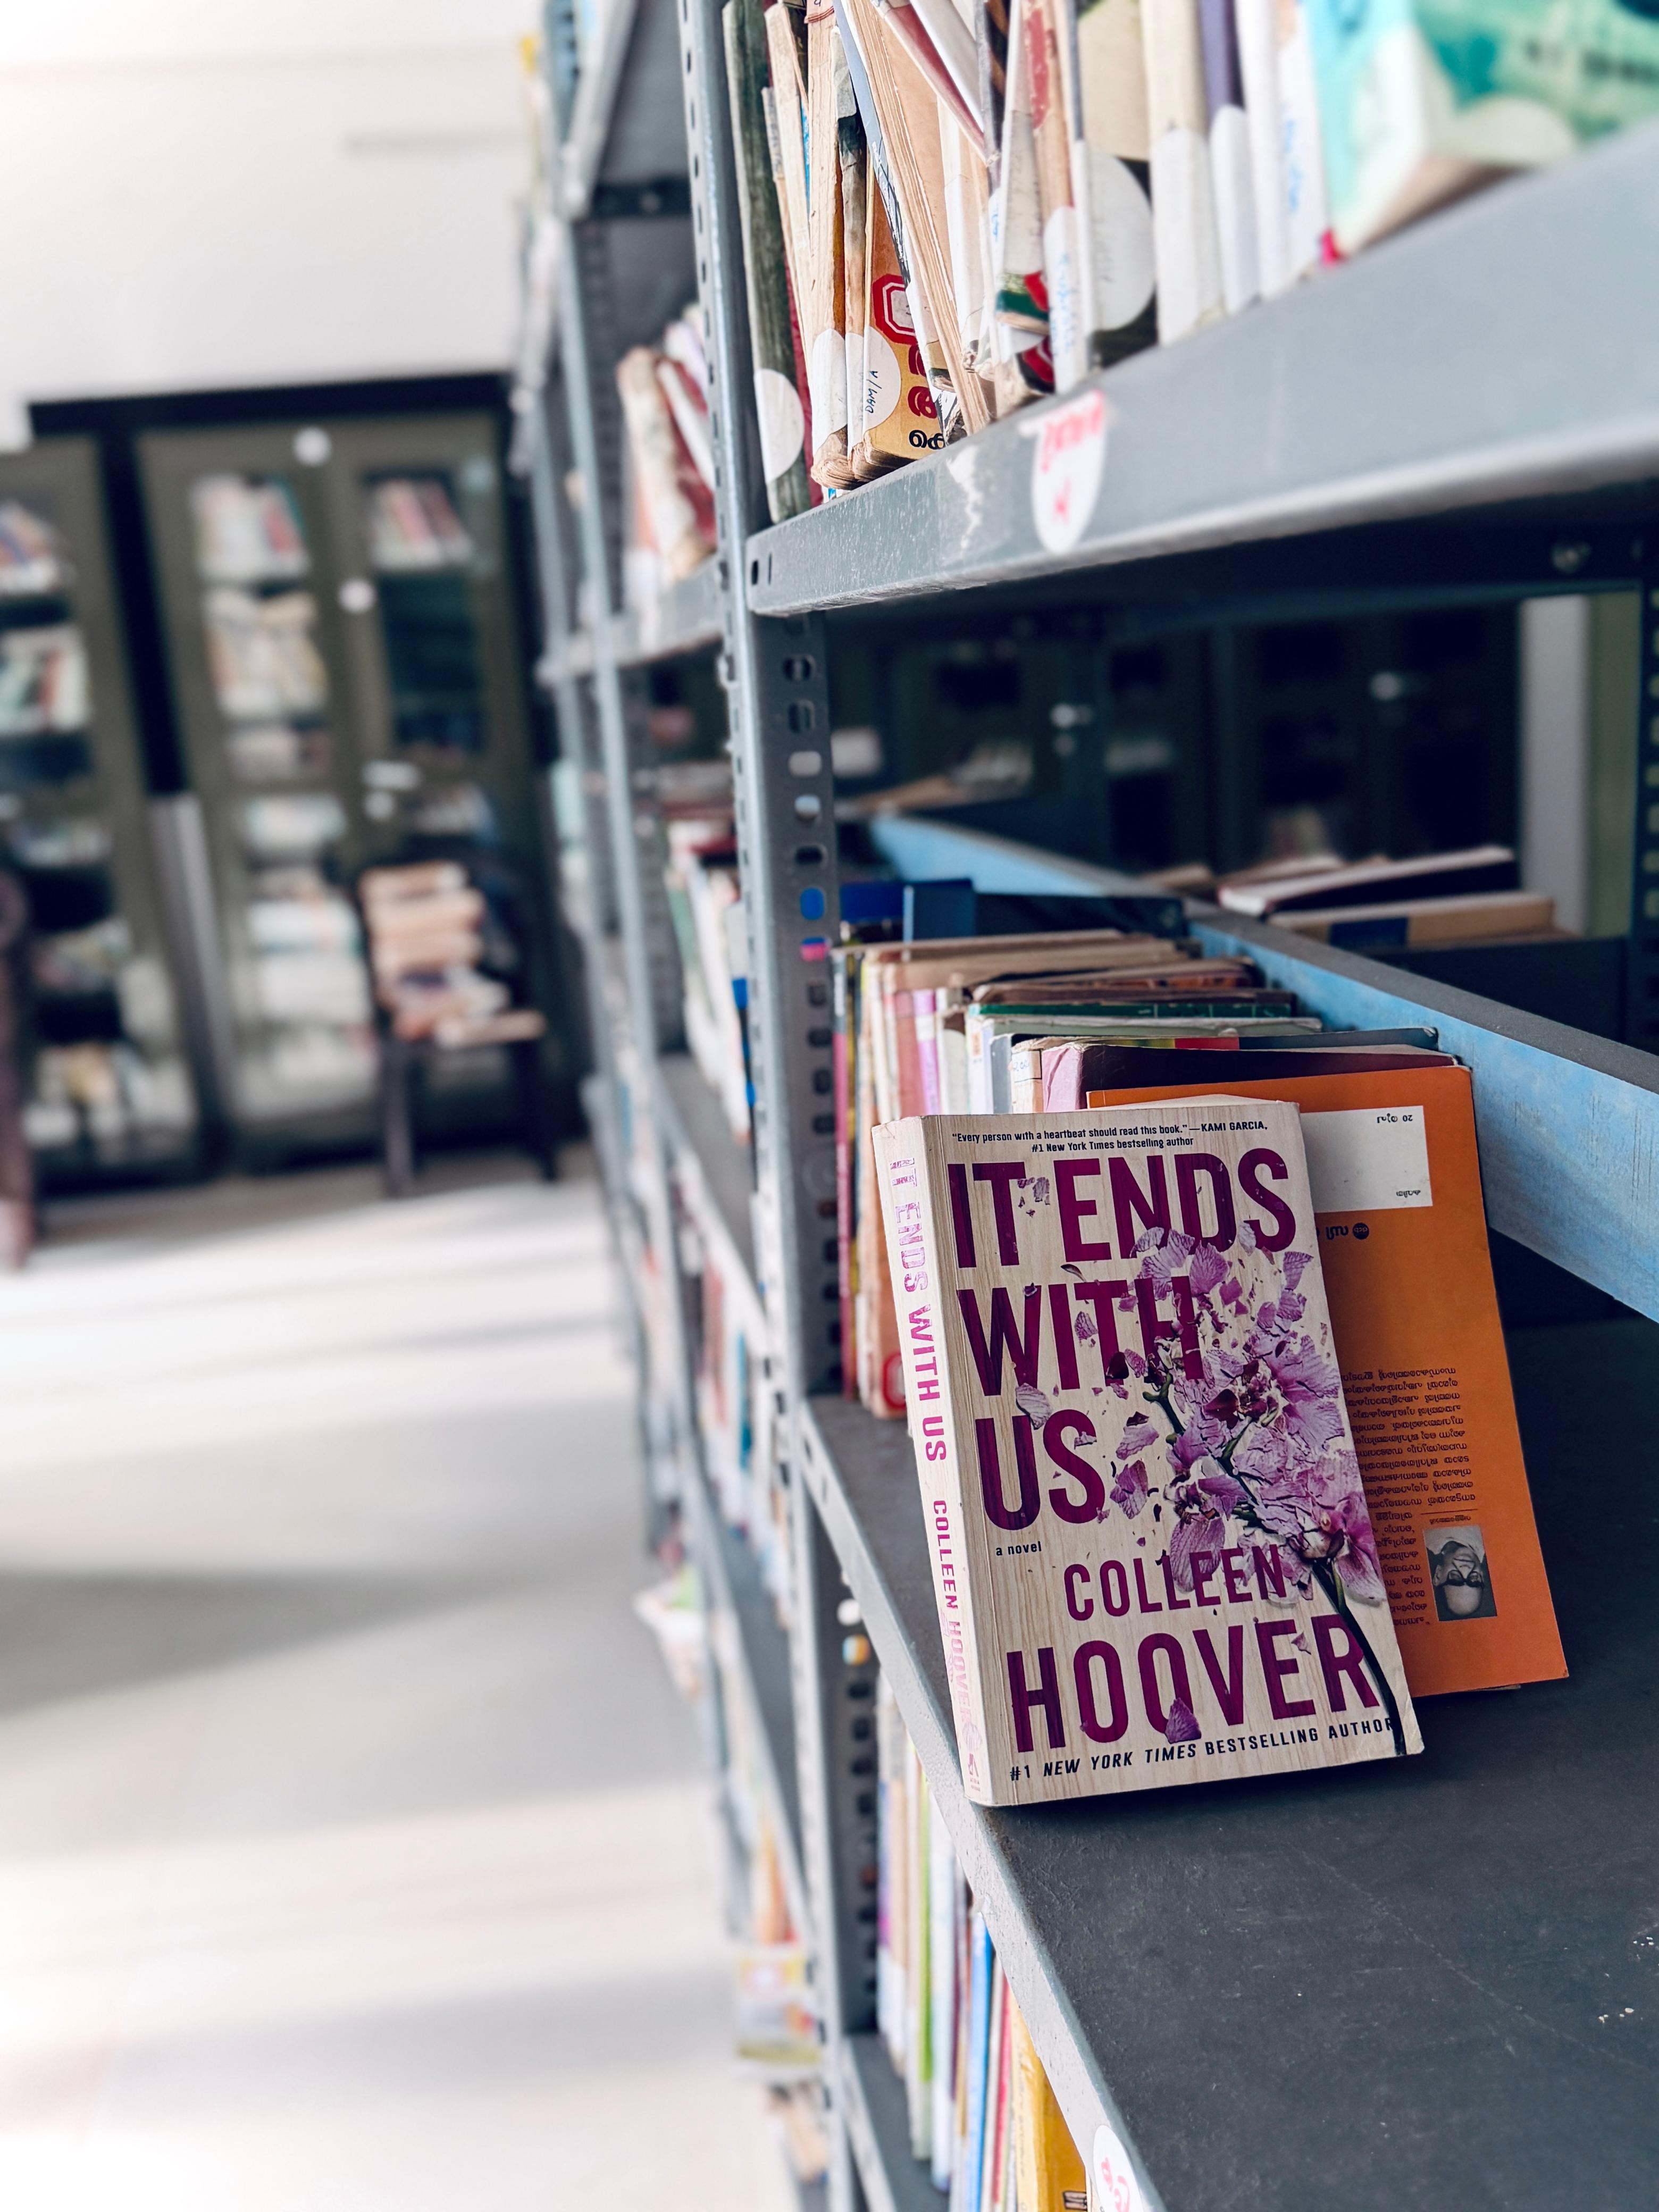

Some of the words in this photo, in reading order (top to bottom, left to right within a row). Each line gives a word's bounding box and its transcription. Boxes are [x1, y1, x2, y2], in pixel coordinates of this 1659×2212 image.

[952, 1133, 979, 1144] “Every
[983, 1133, 1011, 1143] person
[1015, 1131, 1034, 1141] with
[1044, 1129, 1086, 1139] heartbeat
[1089, 1126, 1117, 1137] should
[1119, 1126, 1138, 1136] read
[1141, 1126, 1157, 1135] this
[1229, 1121, 1268, 1130] GARCIA,
[1032, 1144, 1044, 1152] #1
[1046, 1143, 1065, 1152] New
[1067, 1142, 1087, 1151] York
[1089, 1140, 1115, 1150] Times
[1117, 1138, 1164, 1149] bestselling
[1167, 1137, 1194, 1146] author
[890, 1158, 917, 1187] IT
[948, 1161, 1026, 1268] IT
[1053, 1148, 1296, 1262] ENDS
[1396, 1189, 1421, 1198] കവിത
[895, 1202, 928, 1292] ENDS
[909, 1304, 940, 1401] WITH
[956, 1276, 1204, 1396] WITH
[923, 1415, 946, 1461] US
[975, 1409, 1105, 1530] US
[996, 1546, 1003, 1556] a
[1008, 1541, 1042, 1555] novel
[1063, 1544, 1287, 1621] COLLEEN
[933, 1500, 958, 1610] COLLEEN
[949, 1620, 971, 1724] HOOVER
[1007, 1614, 1379, 1753] HOOVER
[1010, 1766, 1030, 1781] #1
[1043, 1758, 1080, 1778] NEW
[1091, 1752, 1133, 1771] YORK
[1145, 1744, 1196, 1763] TIMES
[1205, 1728, 1318, 1755] BESTSELLING
[1328, 1717, 1394, 1739] AUTHOR
